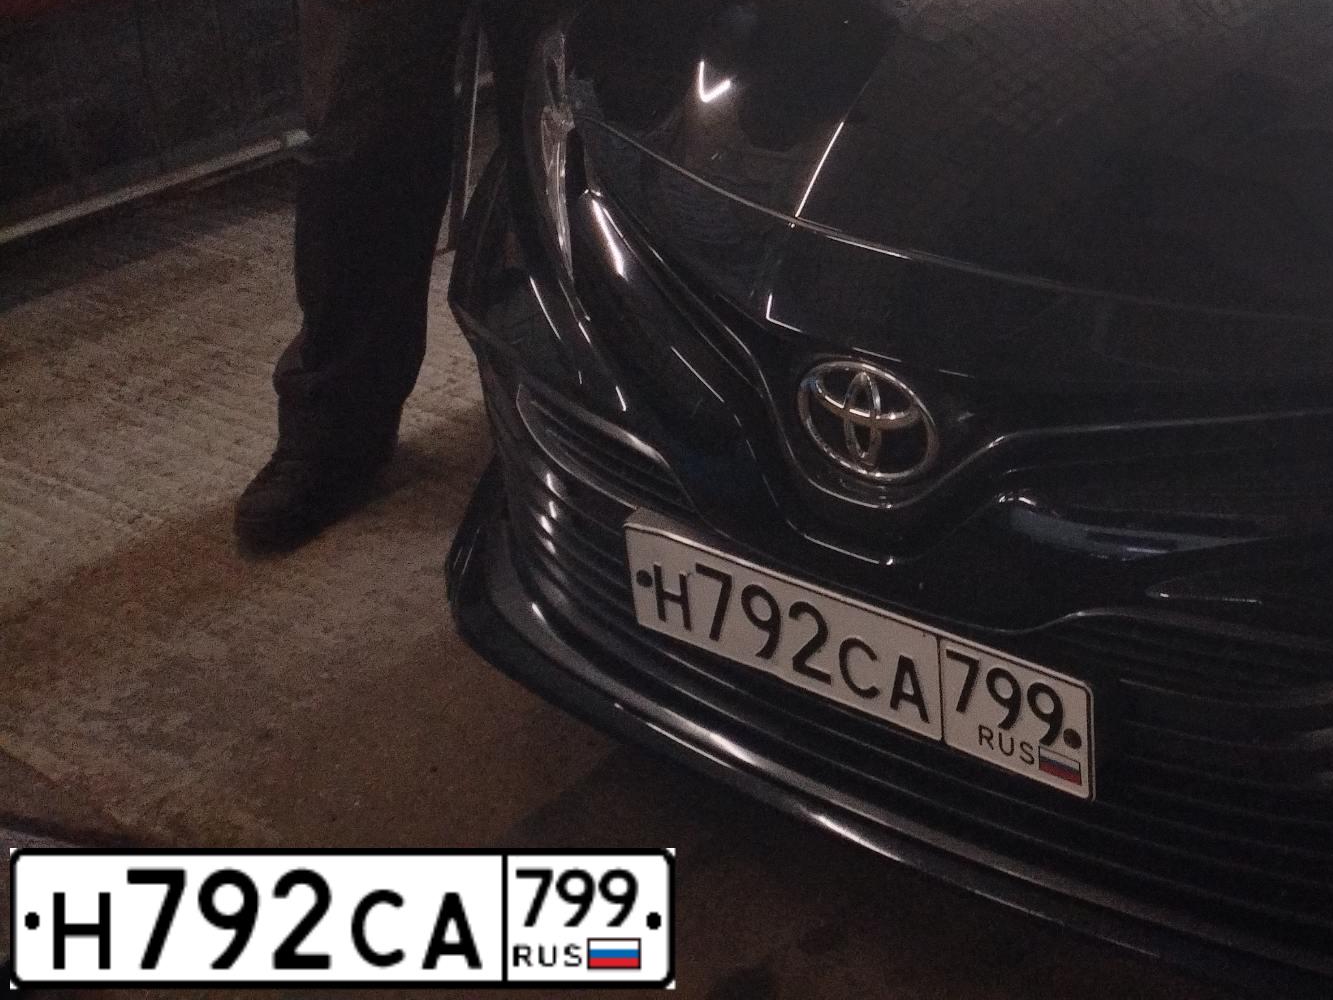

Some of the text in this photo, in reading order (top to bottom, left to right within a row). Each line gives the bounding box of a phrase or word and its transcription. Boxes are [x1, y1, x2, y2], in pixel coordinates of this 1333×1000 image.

[653, 562, 1066, 747] Н792СА 799
[977, 724, 1036, 766] RUS
